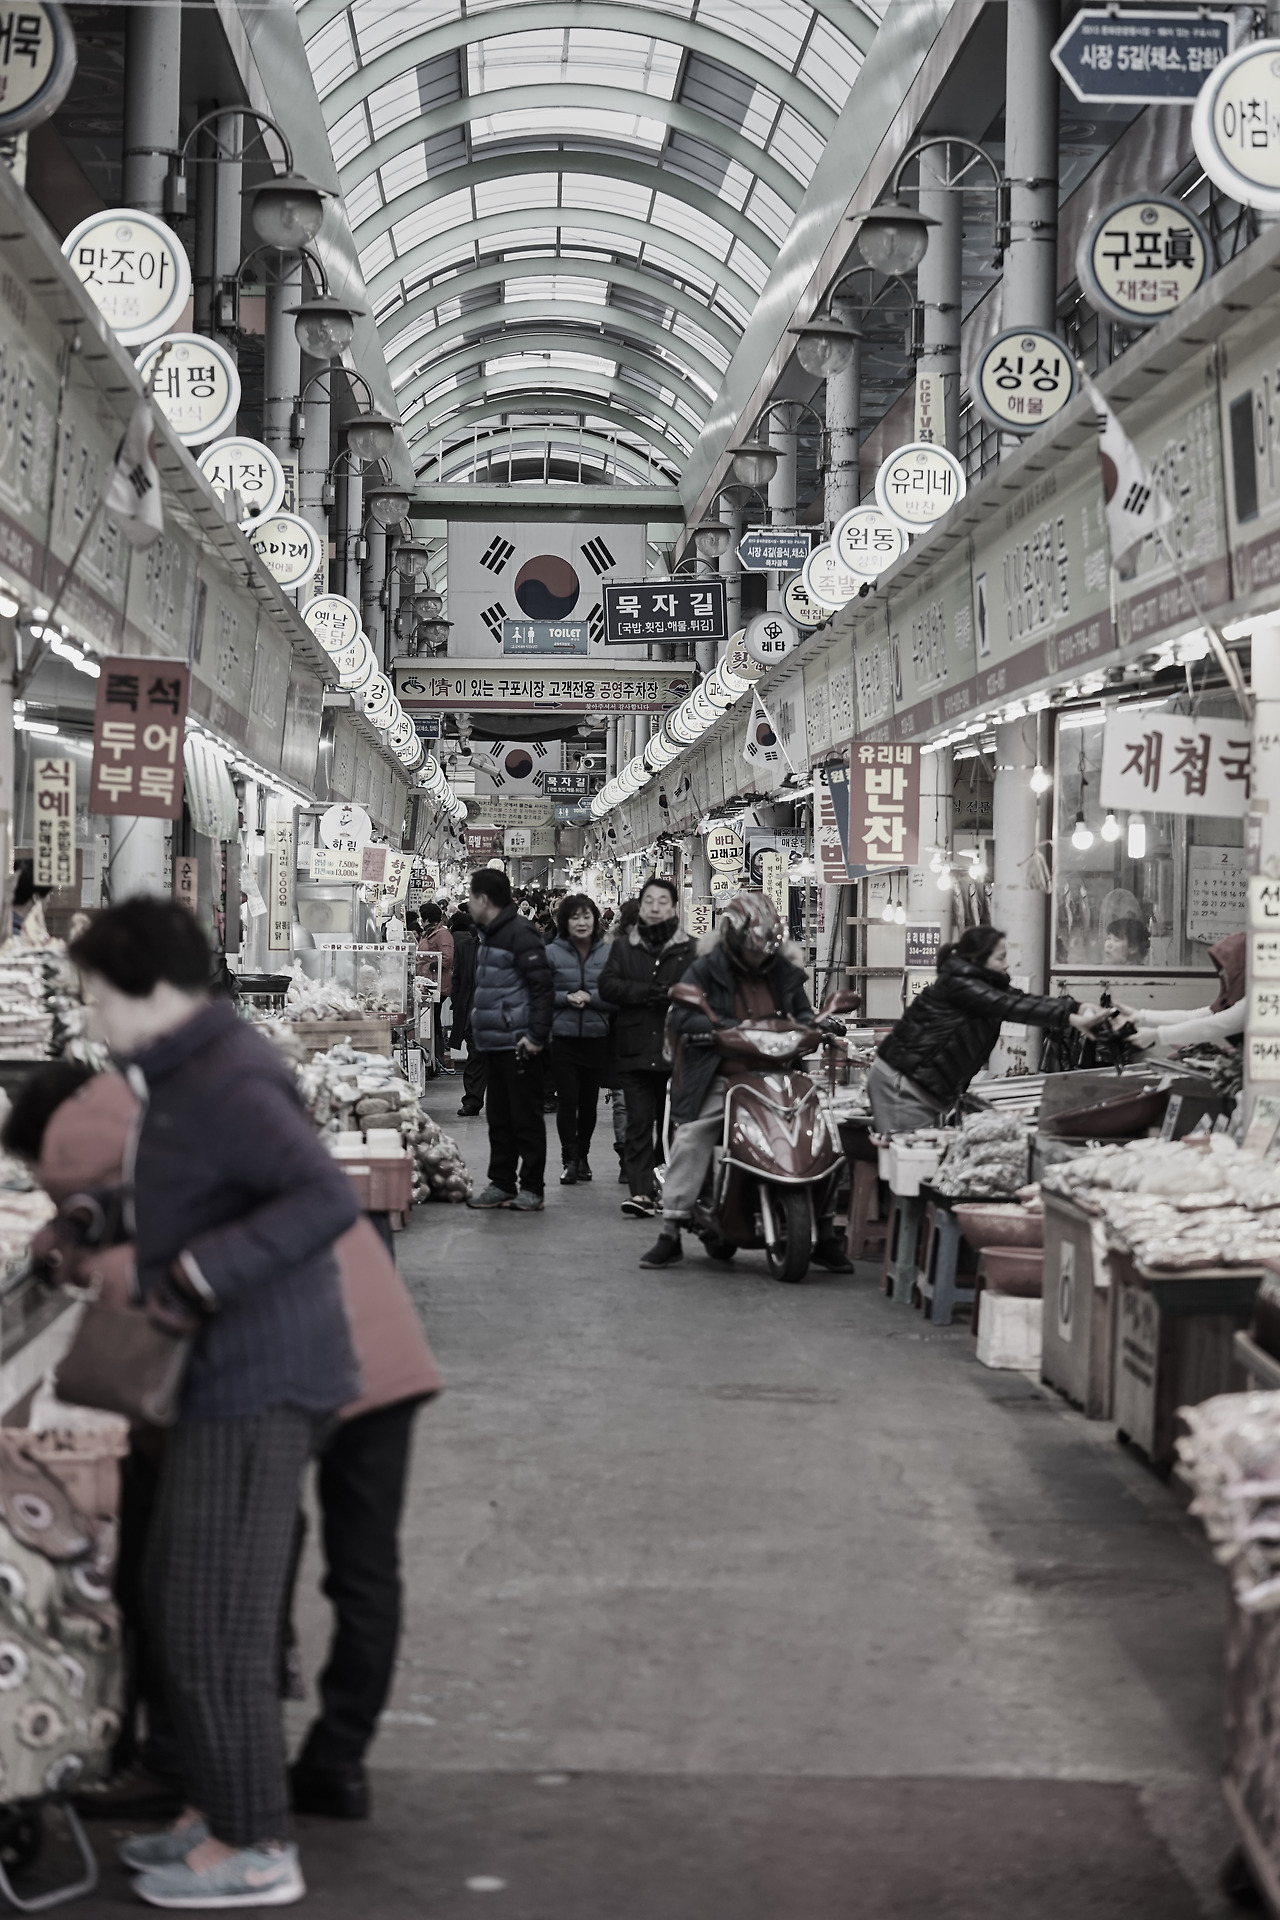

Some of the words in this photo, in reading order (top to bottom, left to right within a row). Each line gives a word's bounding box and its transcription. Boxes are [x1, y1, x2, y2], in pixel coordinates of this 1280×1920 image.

[1080, 44, 1114, 71] 시장
[1224, 98, 1280, 148] 아침
[1103, 227, 1195, 271] 구포眞
[79, 248, 169, 289] 맛조아
[1115, 279, 1181, 303] 재첩국
[150, 365, 216, 398] 태평
[992, 355, 1061, 392] 싱싱
[1007, 396, 1044, 415] 해물
[210, 464, 267, 491] 시장
[891, 468, 952, 495] 유리네
[905, 501, 935, 515] 반찬
[846, 527, 895, 552] 원동
[748, 546, 762, 558] 시장
[791, 585, 810, 606] 육
[818, 575, 857, 596] 족발
[315, 610, 348, 630] 옛날
[800, 609, 822, 620] 떡집
[549, 628, 581, 638] TOILET
[761, 640, 786, 652] 레타
[105, 673, 181, 716] 즉석
[470, 679, 495, 697] 있는
[497, 680, 545, 699] 구포시장
[548, 681, 596, 699] 고객전용
[599, 681, 659, 700] 공영주차장
[97, 720, 137, 803] 두부
[139, 723, 179, 807] 어묵
[858, 745, 912, 765] 유리네
[1120, 730, 1251, 800] 재첩국
[38, 760, 70, 818] 식혜
[862, 767, 908, 862] 반찬
[966, 800, 992, 813] 전문
[332, 839, 357, 852] 하림
[714, 834, 735, 846] 바다
[1221, 853, 1228, 863] 2
[906, 932, 940, 944] 유리네반찬
